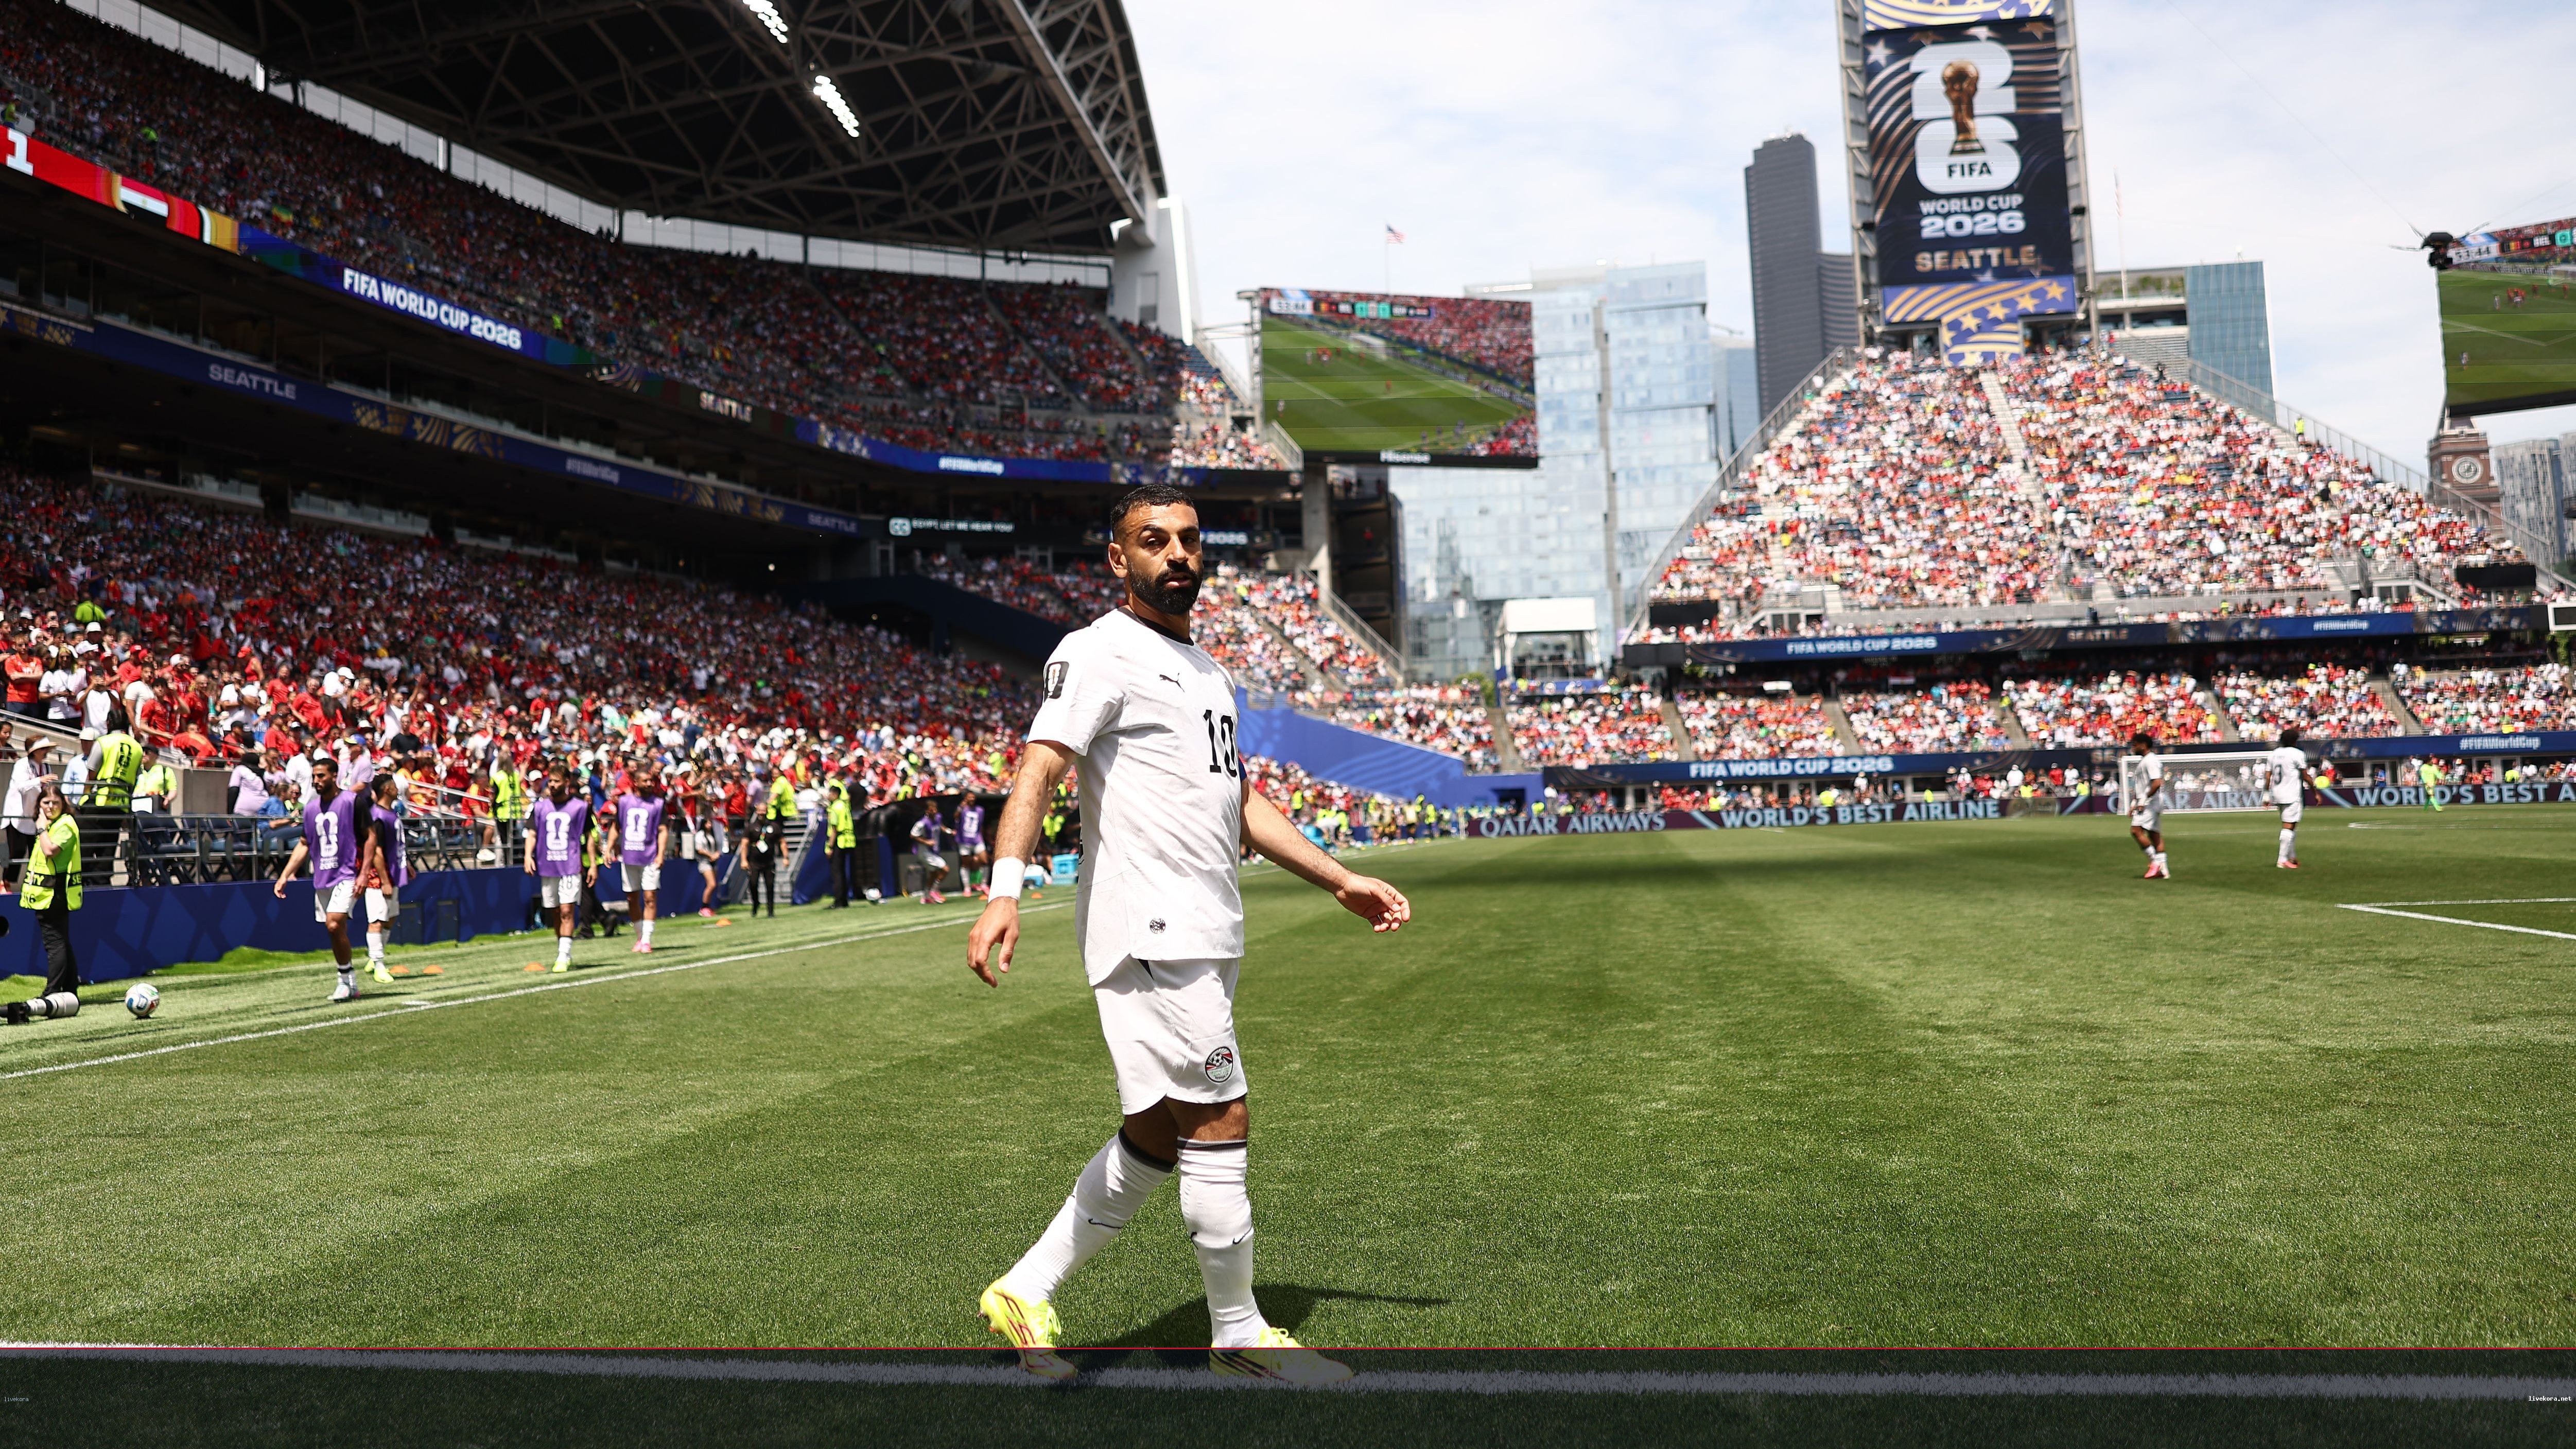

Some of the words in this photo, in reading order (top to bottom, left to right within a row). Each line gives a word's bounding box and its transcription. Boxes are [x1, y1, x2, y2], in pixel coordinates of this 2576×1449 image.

[7, 128, 33, 176] 1
[1947, 162, 1991, 179] FIFA
[1919, 196, 1985, 216] WORLD
[1986, 193, 2024, 211] CUP
[1920, 210, 2026, 239] 2026
[1914, 244, 2037, 272] SEATTLE
[343, 267, 379, 301] FIFA
[380, 281, 438, 321] WORLD
[439, 302, 469, 331] CUP
[469, 314, 522, 350] 2026
[209, 363, 296, 400] SEATTLE
[1786, 641, 1816, 655] FIFA
[1816, 639, 1863, 654] WORLD
[1864, 638, 1890, 652] CUP
[1890, 636, 1938, 650] 2026
[2067, 629, 2129, 641] SEATTLE
[1203, 709, 1238, 778] 10
[2460, 735, 2541, 750] #FIFAWorldCup
[1689, 762, 1728, 778] FIFA
[1728, 759, 1792, 776] WORLD
[1794, 757, 1830, 775] CUP
[1831, 756, 1894, 773] 2026
[2482, 782, 2550, 804] BEST
[1480, 814, 1560, 837] QATAR
[1567, 812, 1666, 835] AIRWAYS
[1720, 806, 1831, 828] WORLD'S
[1836, 802, 1896, 825] BEST
[1903, 799, 2001, 822] AIRLINE
